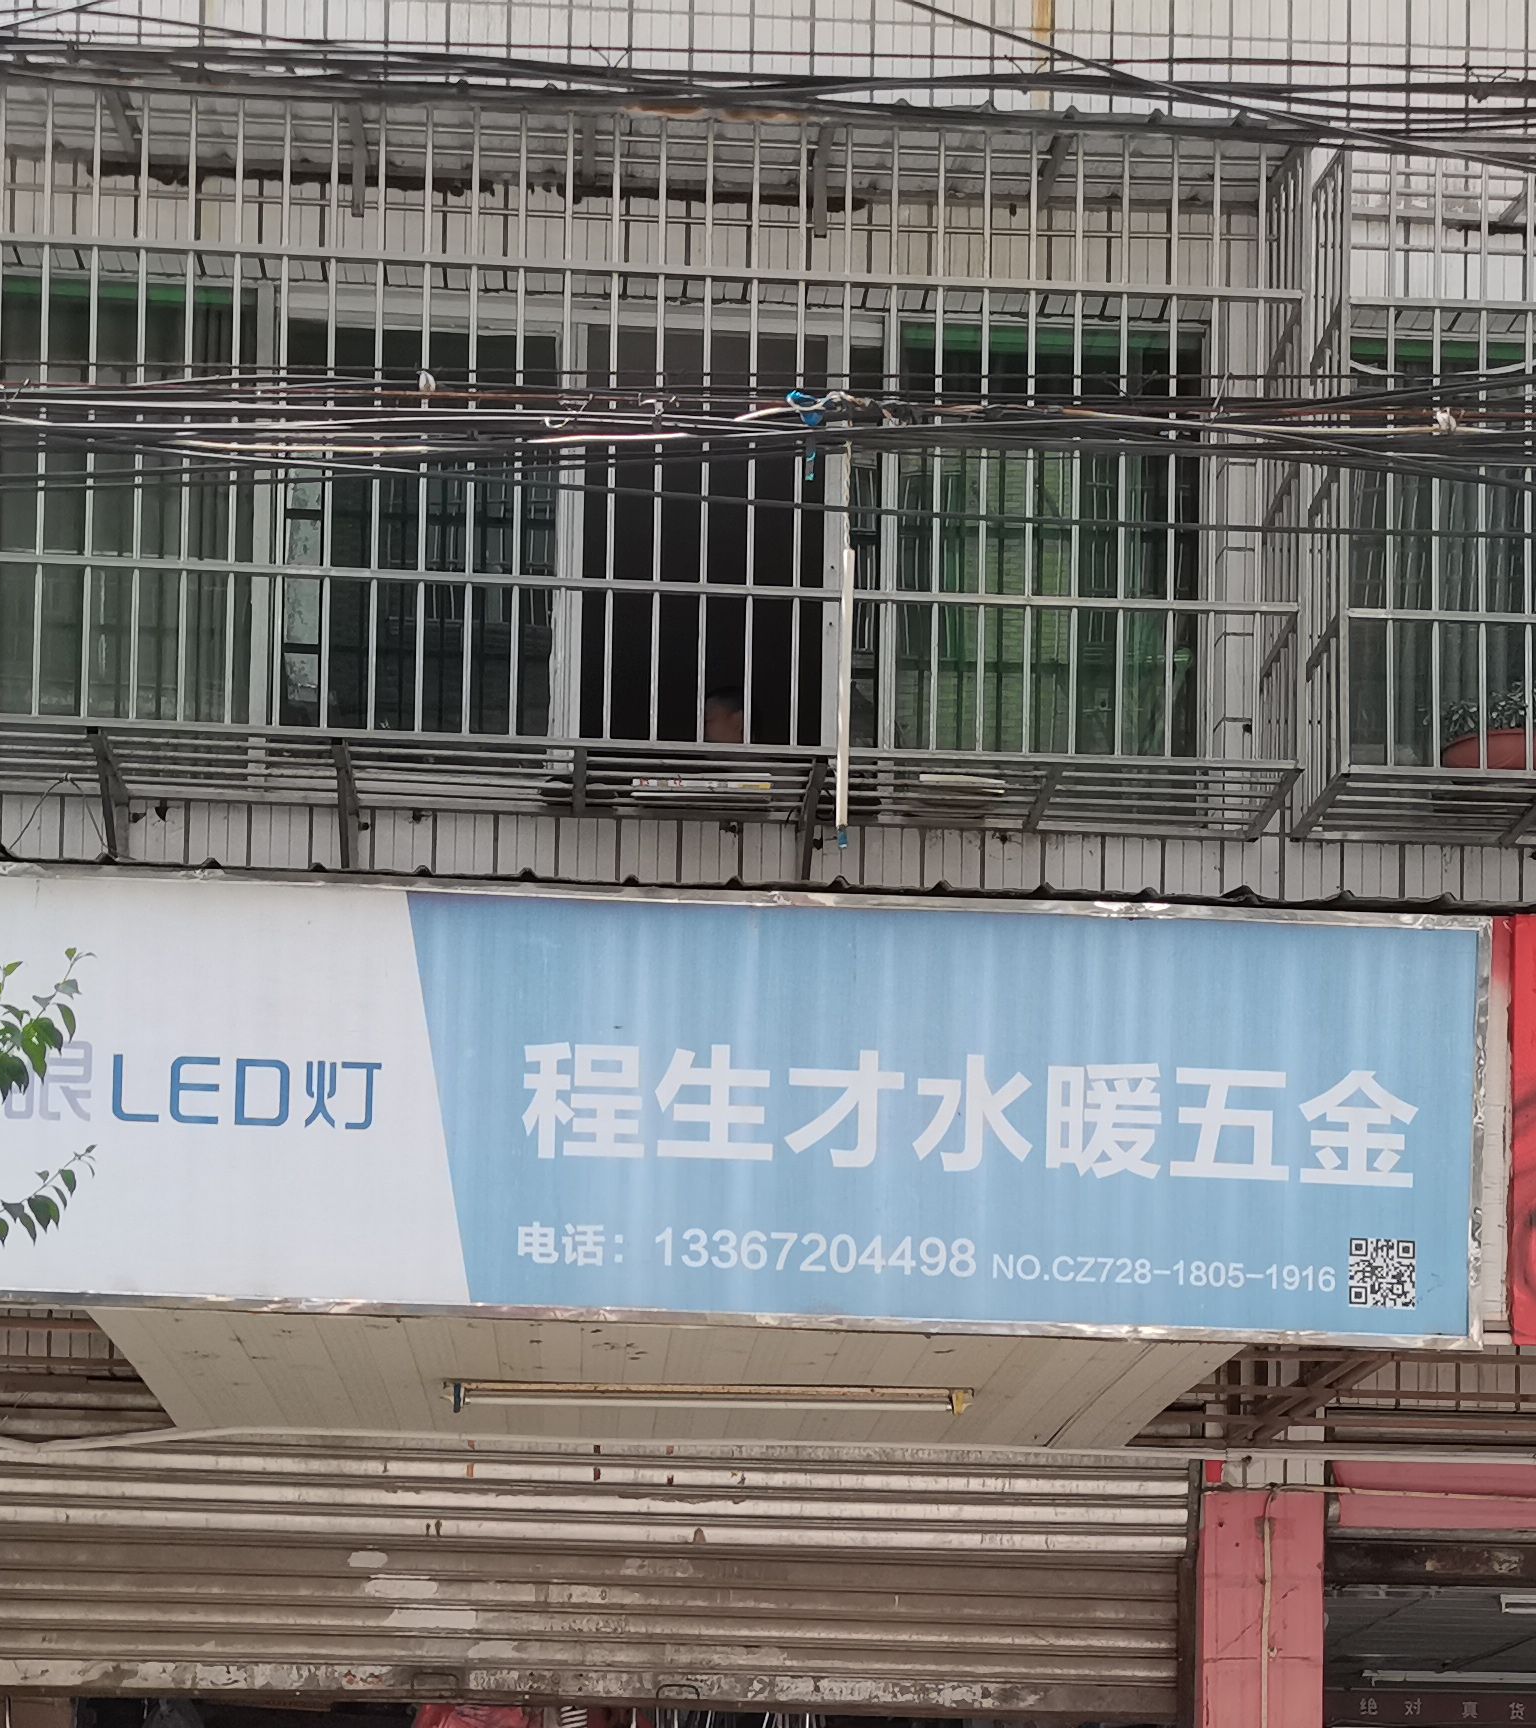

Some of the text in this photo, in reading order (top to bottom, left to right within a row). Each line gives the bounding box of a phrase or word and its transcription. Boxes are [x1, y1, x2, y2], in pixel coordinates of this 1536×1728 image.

[522, 1042, 1418, 1188] 程生才水暖五金
[654, 1226, 977, 1279] 13367204498
[991, 1253, 1337, 1294] NO.CZ728-1805-1916
[1359, 1697, 1527, 1721] 绝对真货
